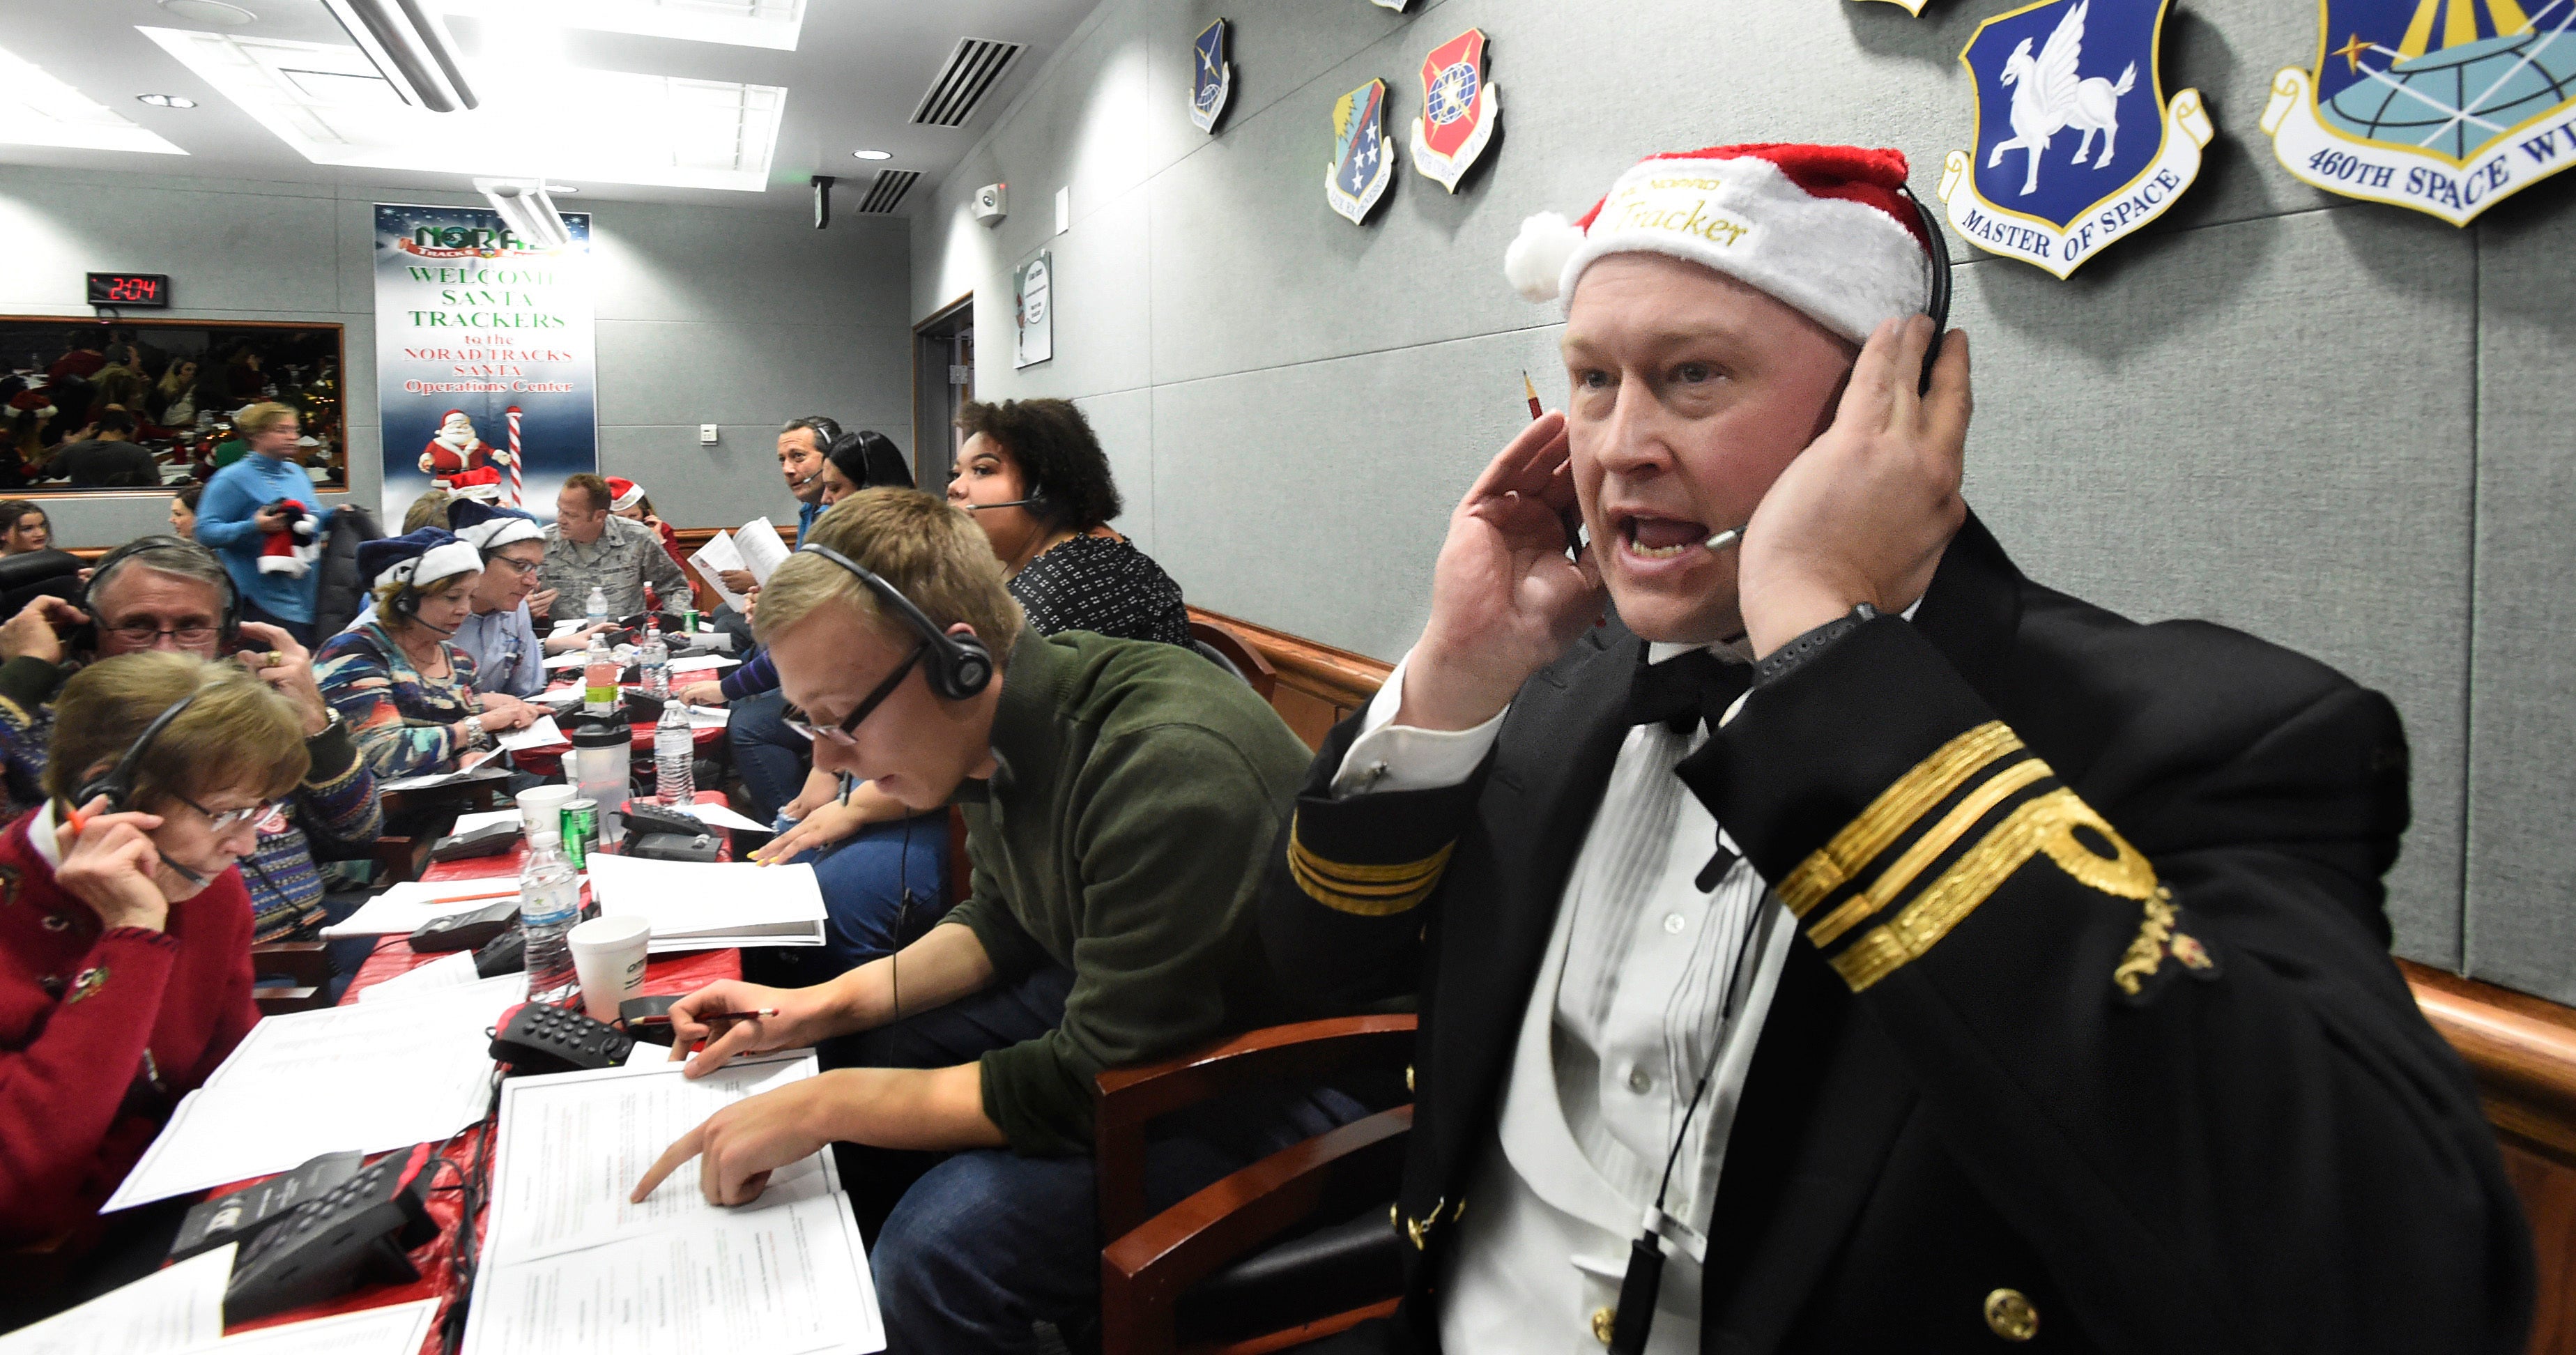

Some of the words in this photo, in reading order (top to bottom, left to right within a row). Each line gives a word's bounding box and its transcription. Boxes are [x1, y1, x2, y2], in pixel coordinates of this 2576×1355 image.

[2309, 148, 2395, 188] 460TH
[2406, 155, 2509, 210] SPACE
[2517, 118, 2576, 164] WI
[1614, 199, 1748, 247] Tracker
[1962, 208, 2050, 258] MASTER
[2064, 222, 2094, 261] OF
[2100, 169, 2180, 234] SPACE
[414, 225, 548, 251] NORA
[109, 277, 155, 300] 2:04
[442, 289, 532, 306] SANTA
[408, 311, 565, 328] TRACKERS
[465, 335, 482, 345] to
[487, 333, 514, 345] the
[404, 349, 482, 361] NORAD
[486, 349, 572, 362] TRACKS
[453, 364, 523, 377] SANTA
[405, 378, 508, 396] Operations
[512, 378, 574, 393] Center
